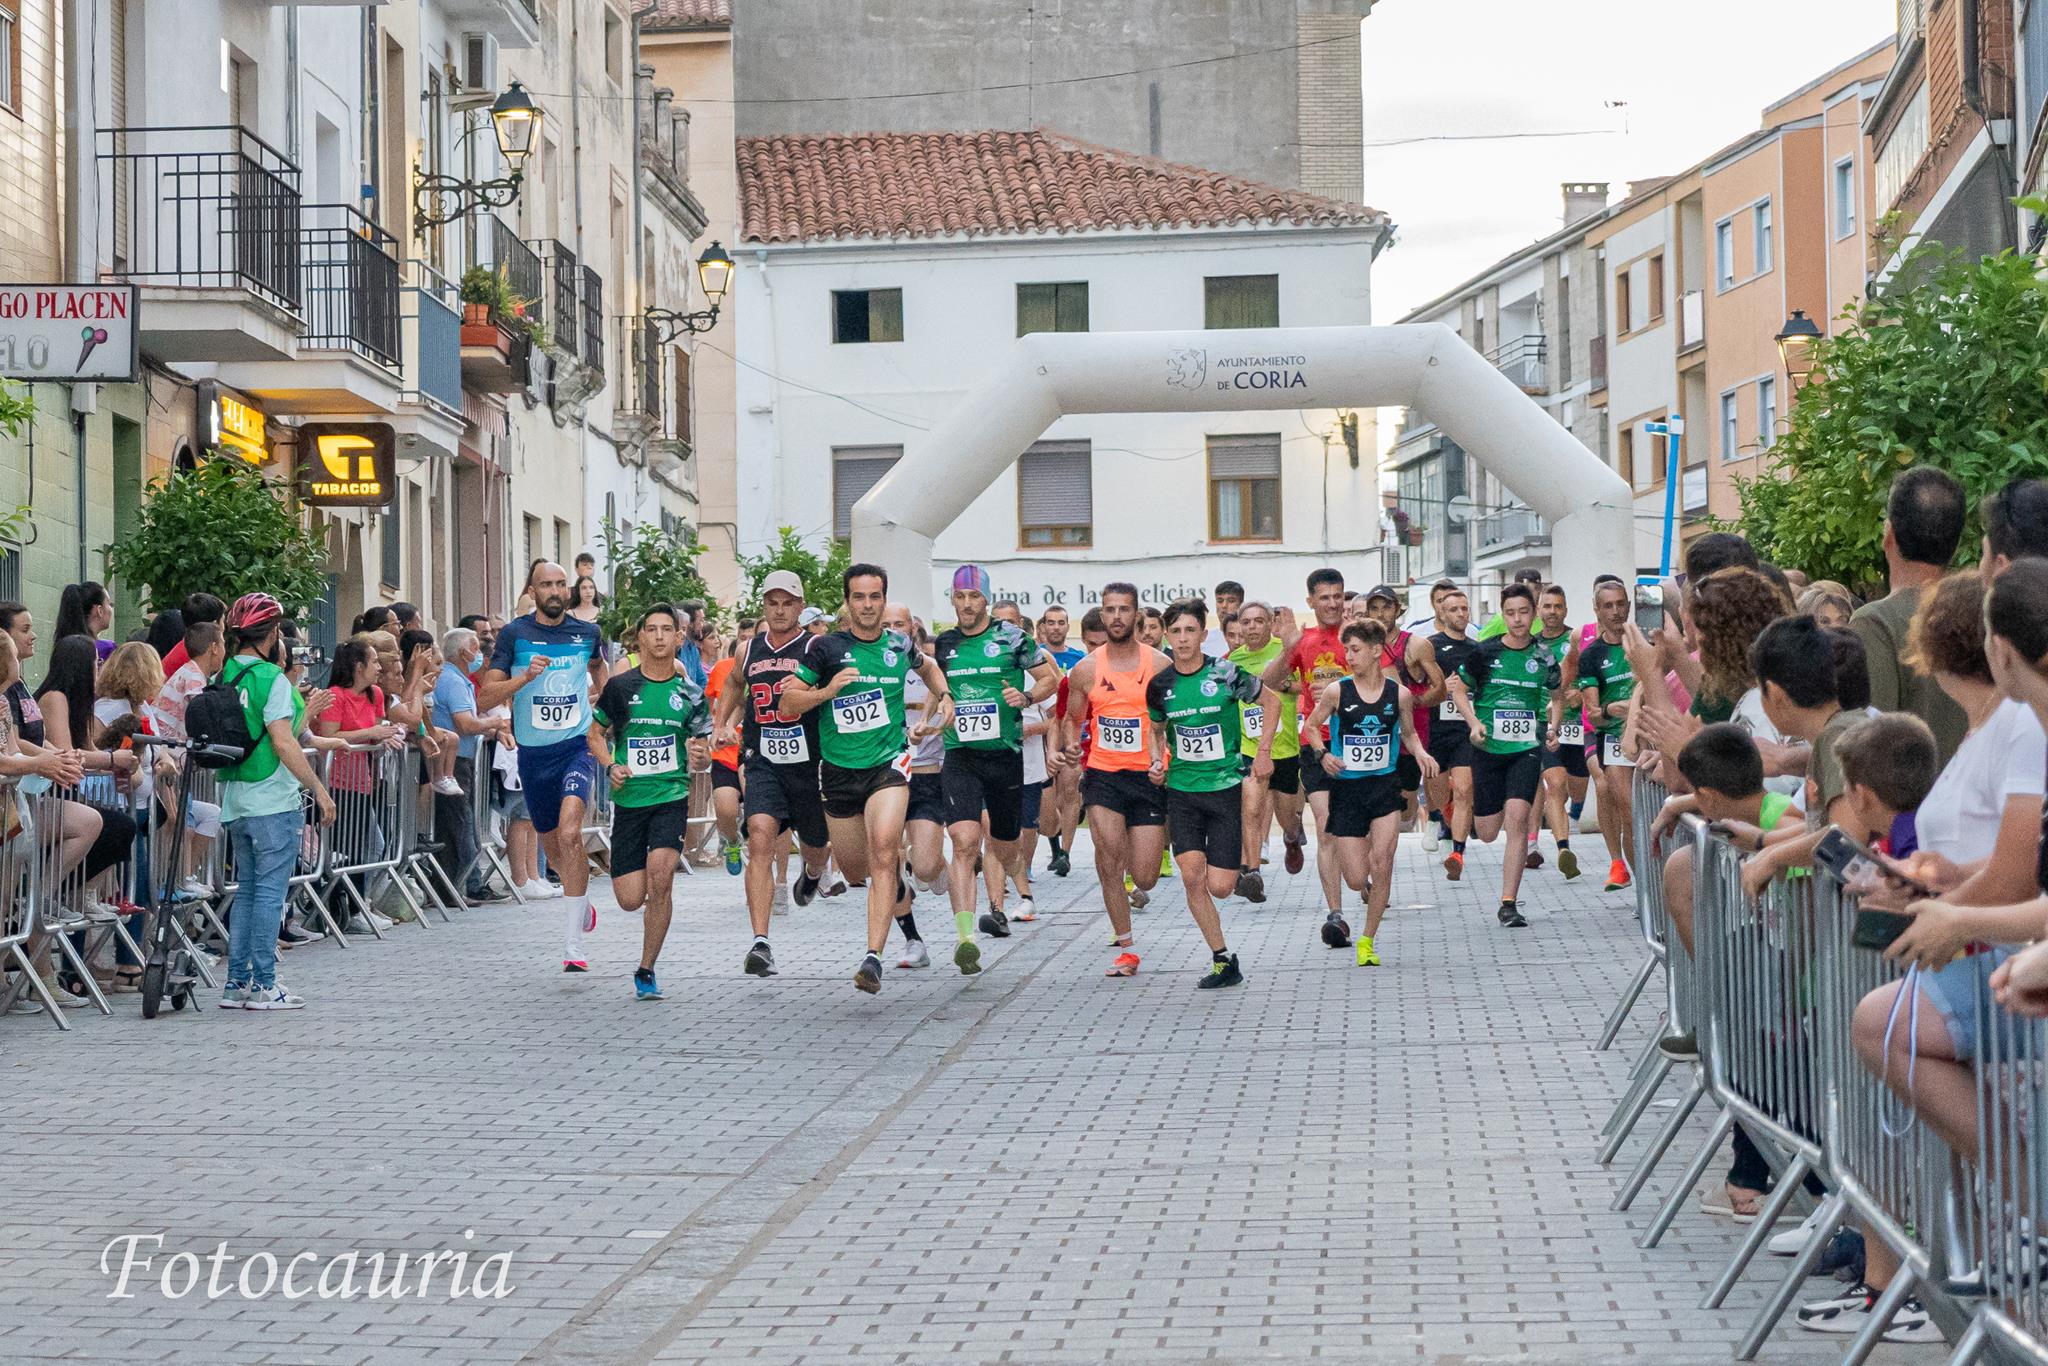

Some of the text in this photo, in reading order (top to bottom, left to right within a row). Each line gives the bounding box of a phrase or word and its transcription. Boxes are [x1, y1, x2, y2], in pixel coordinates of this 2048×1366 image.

[0, 292, 127, 319] GO PLACEN
[1217, 356, 1306, 368] AYUNTAMIENTO
[1217, 370, 1307, 390] DE CORIA
[312, 482, 381, 496] TABACOS
[1043, 584, 1066, 605] de
[1141, 583, 1207, 606] elicias
[748, 658, 800, 677] CHICAGO
[842, 693, 872, 706] CORIA
[540, 705, 574, 722] 907
[842, 702, 880, 725] 902
[959, 705, 987, 714] CORIA
[958, 715, 992, 733] 879
[1104, 718, 1131, 726] CORIA
[1249, 716, 1264, 730] 95
[1502, 720, 1530, 734] 883
[1103, 727, 1135, 745] 898
[1182, 728, 1210, 736] CORIA
[638, 738, 668, 747] CORIA
[767, 739, 800, 756] 889
[1182, 736, 1214, 754] 921
[636, 747, 671, 766] 884
[1351, 746, 1384, 763] 929
